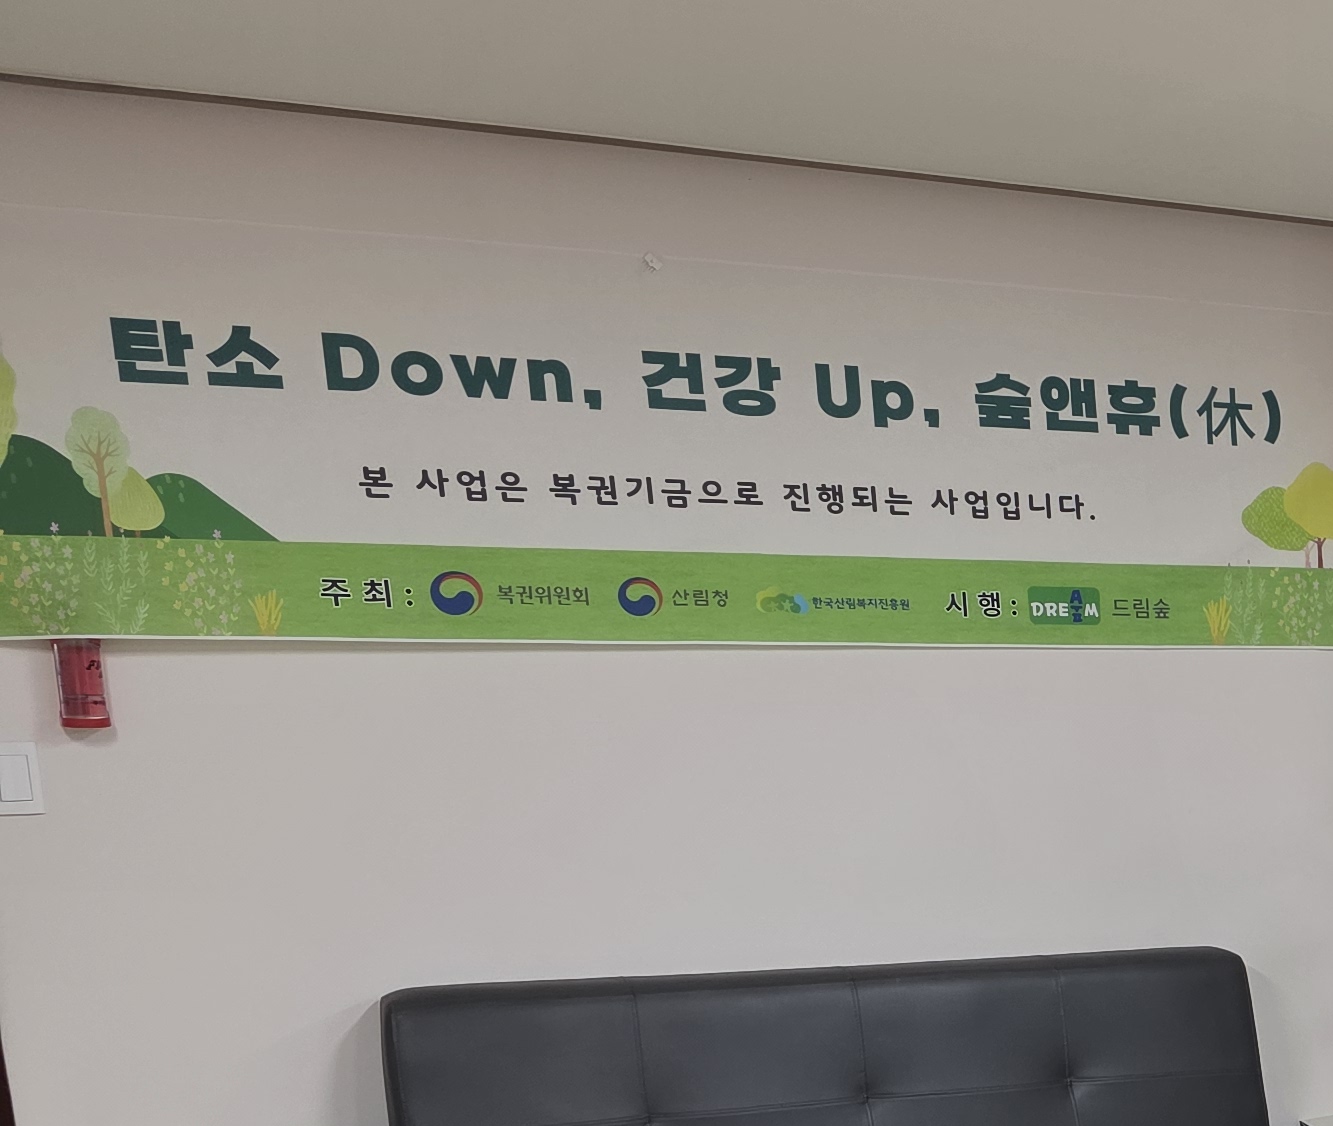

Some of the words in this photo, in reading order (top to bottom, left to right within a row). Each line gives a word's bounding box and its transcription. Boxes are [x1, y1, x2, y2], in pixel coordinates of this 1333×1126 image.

[110, 316, 284, 389] 탄소
[321, 331, 602, 410] Down,
[641, 350, 781, 417] 건강
[815, 363, 941, 428] Up,
[974, 371, 1282, 446] 숲앤휴(休)
[358, 466, 393, 498] 본
[416, 467, 529, 503] 사업은
[548, 473, 764, 508] 복권기금으로
[783, 483, 913, 516] 진행되는
[930, 491, 1097, 521] 사업입니다.
[497, 584, 590, 608] 복권위원회
[671, 587, 730, 608] 산림청
[812, 597, 911, 610] 한국산림복지진흥원
[1112, 598, 1171, 619] 드림숲
